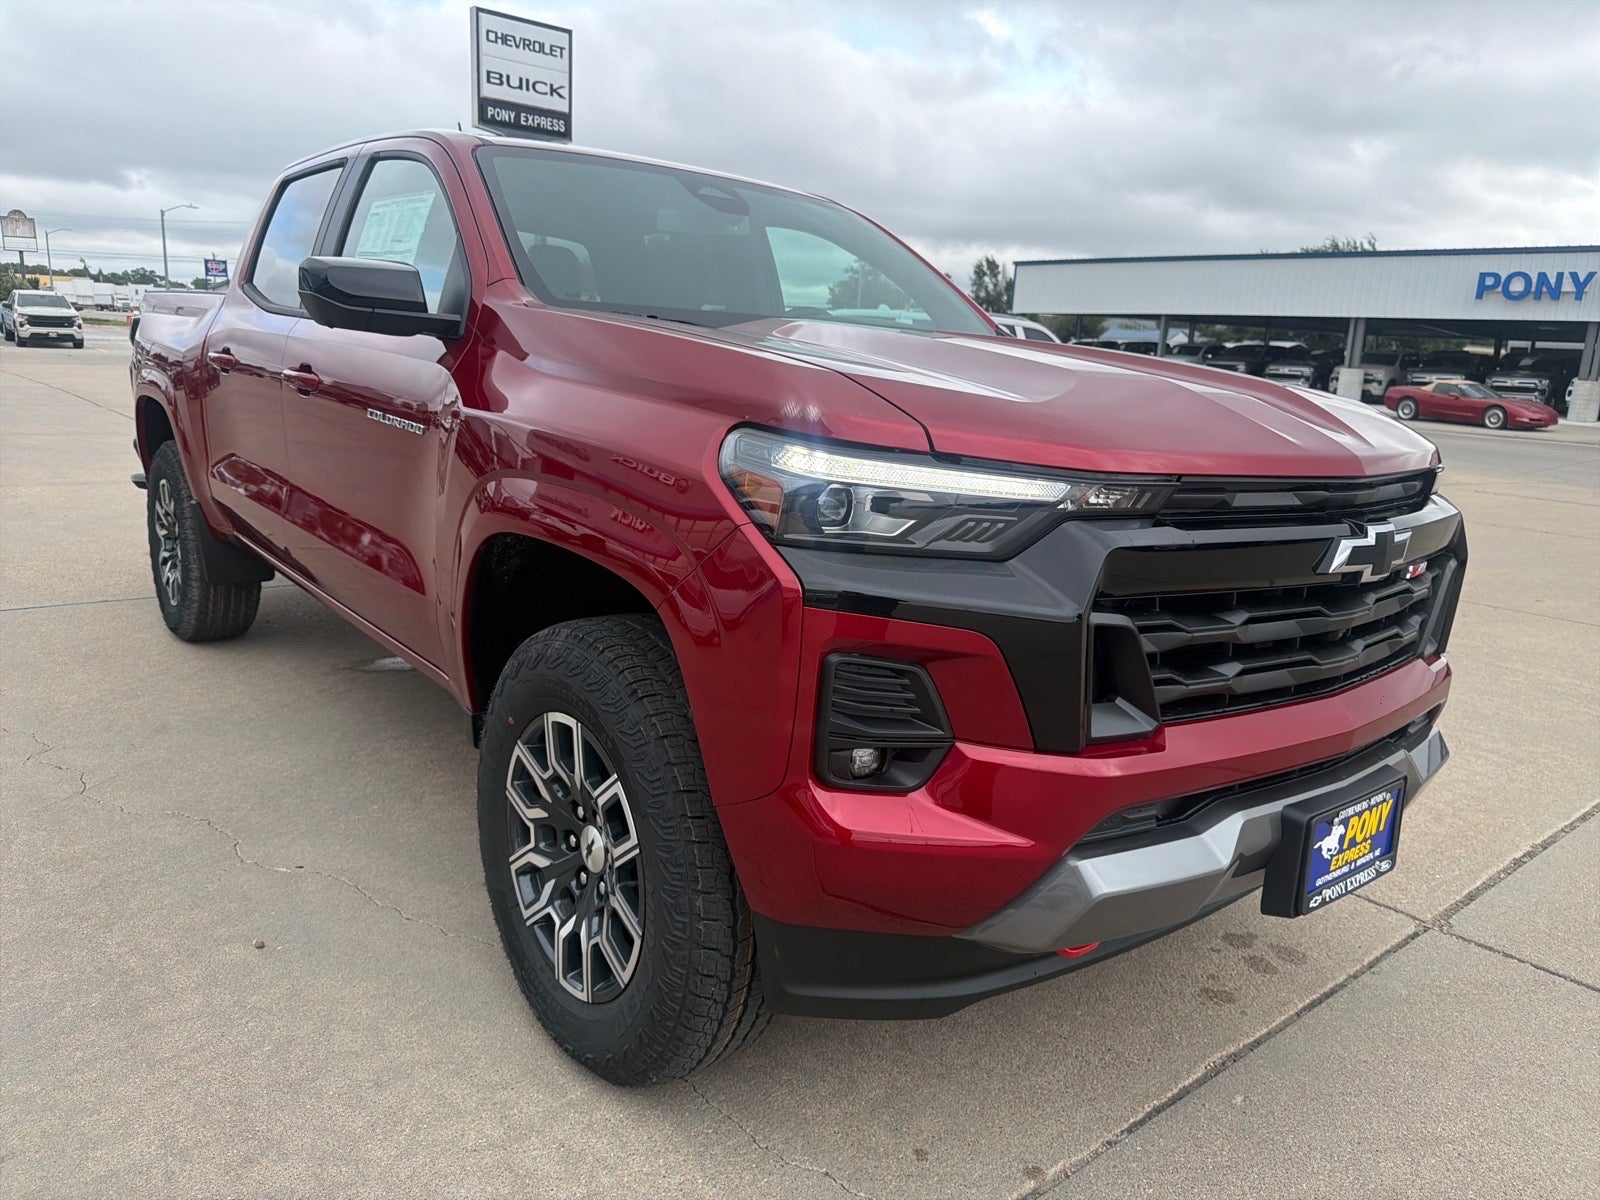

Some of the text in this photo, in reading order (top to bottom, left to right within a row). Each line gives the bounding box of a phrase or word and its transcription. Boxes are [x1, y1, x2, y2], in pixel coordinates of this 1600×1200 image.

[486, 29, 566, 59] CHEVROLET
[486, 70, 566, 100] BUICK
[487, 106, 565, 132] PONY EXPRESS
[1475, 271, 1597, 301] PONY
[1343, 799, 1393, 849] PONY
[1330, 840, 1371, 871] EXPRESS
[1325, 867, 1376, 902] PONY EXPRESS
